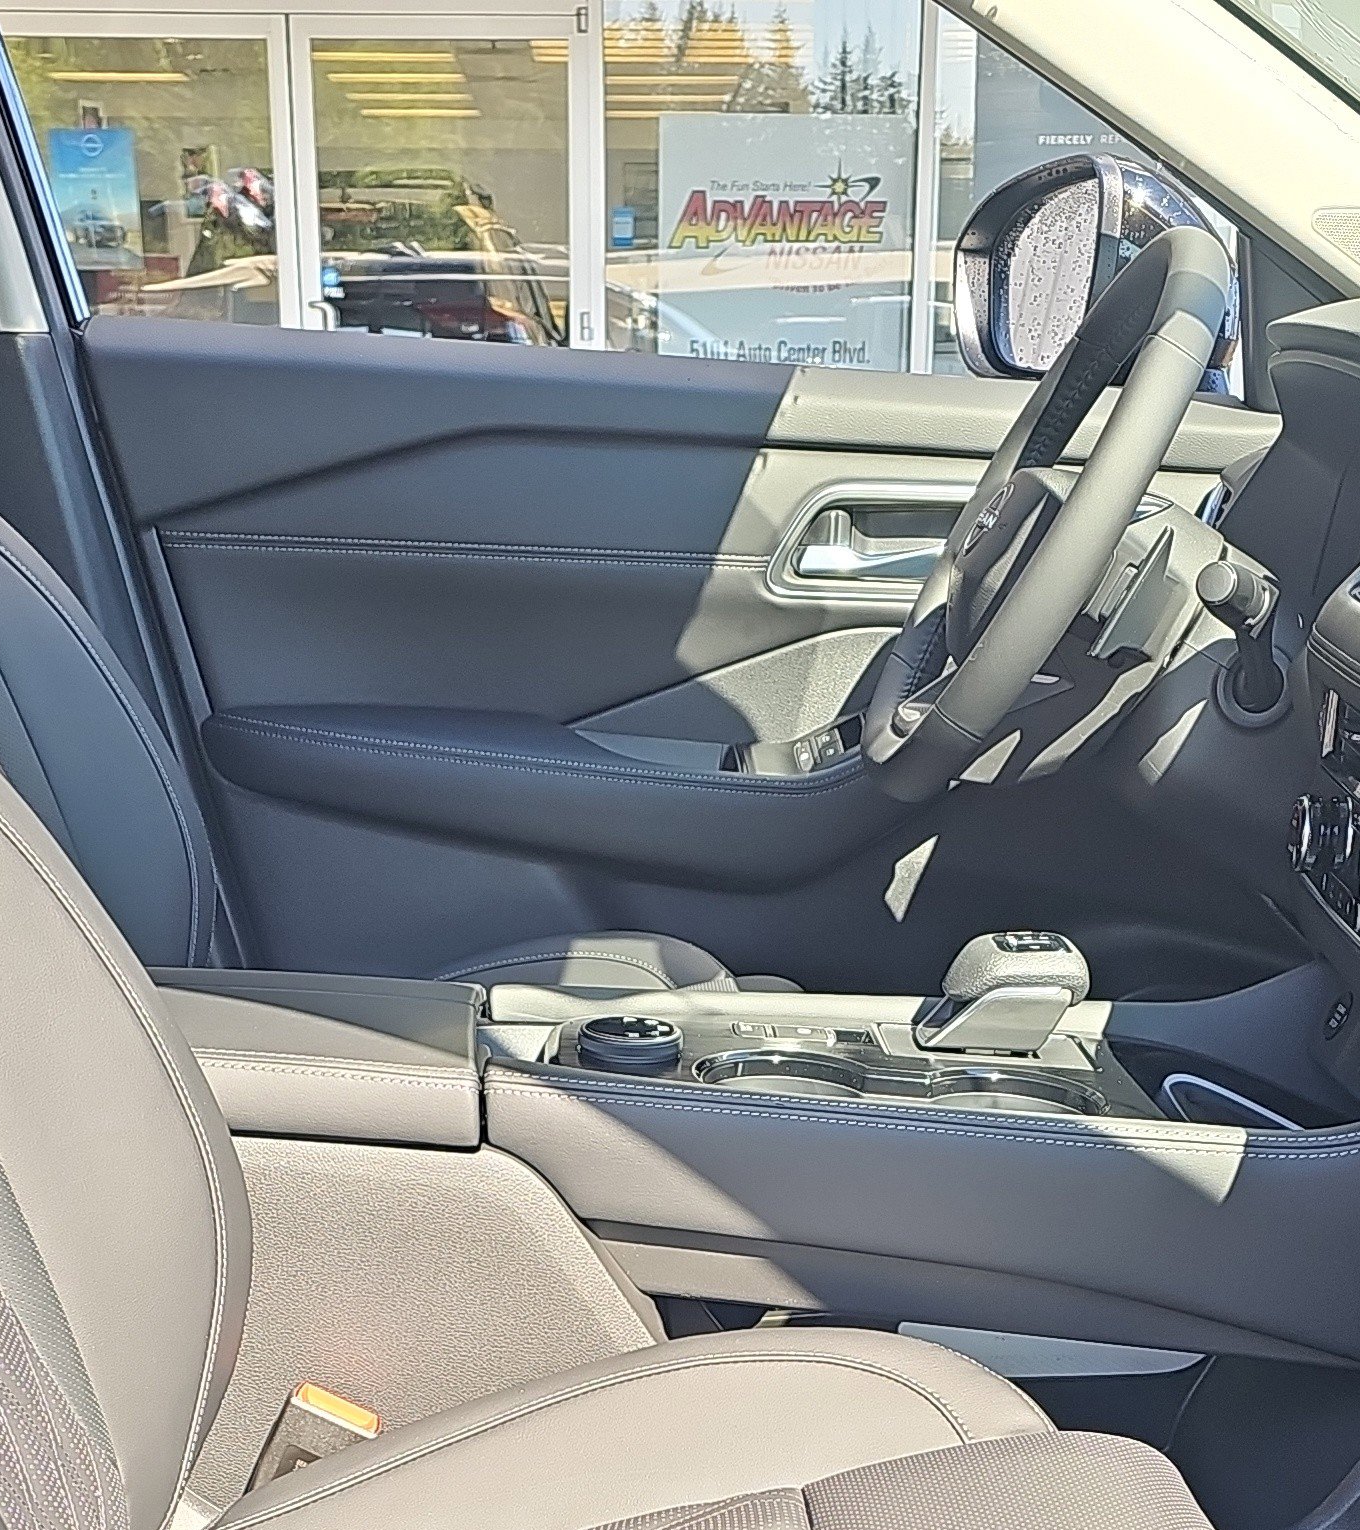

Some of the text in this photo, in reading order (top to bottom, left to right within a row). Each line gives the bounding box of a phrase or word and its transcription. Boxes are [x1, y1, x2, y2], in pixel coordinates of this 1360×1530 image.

[1037, 134, 1094, 146] FIERCELY
[710, 180, 812, 192] The Fun Starts Here!
[667, 189, 888, 249] ADVANTAGE
[764, 245, 864, 270] NISSAN
[736, 340, 772, 362] Auto
[777, 340, 827, 364] Center
[832, 340, 871, 364] Blvd.
